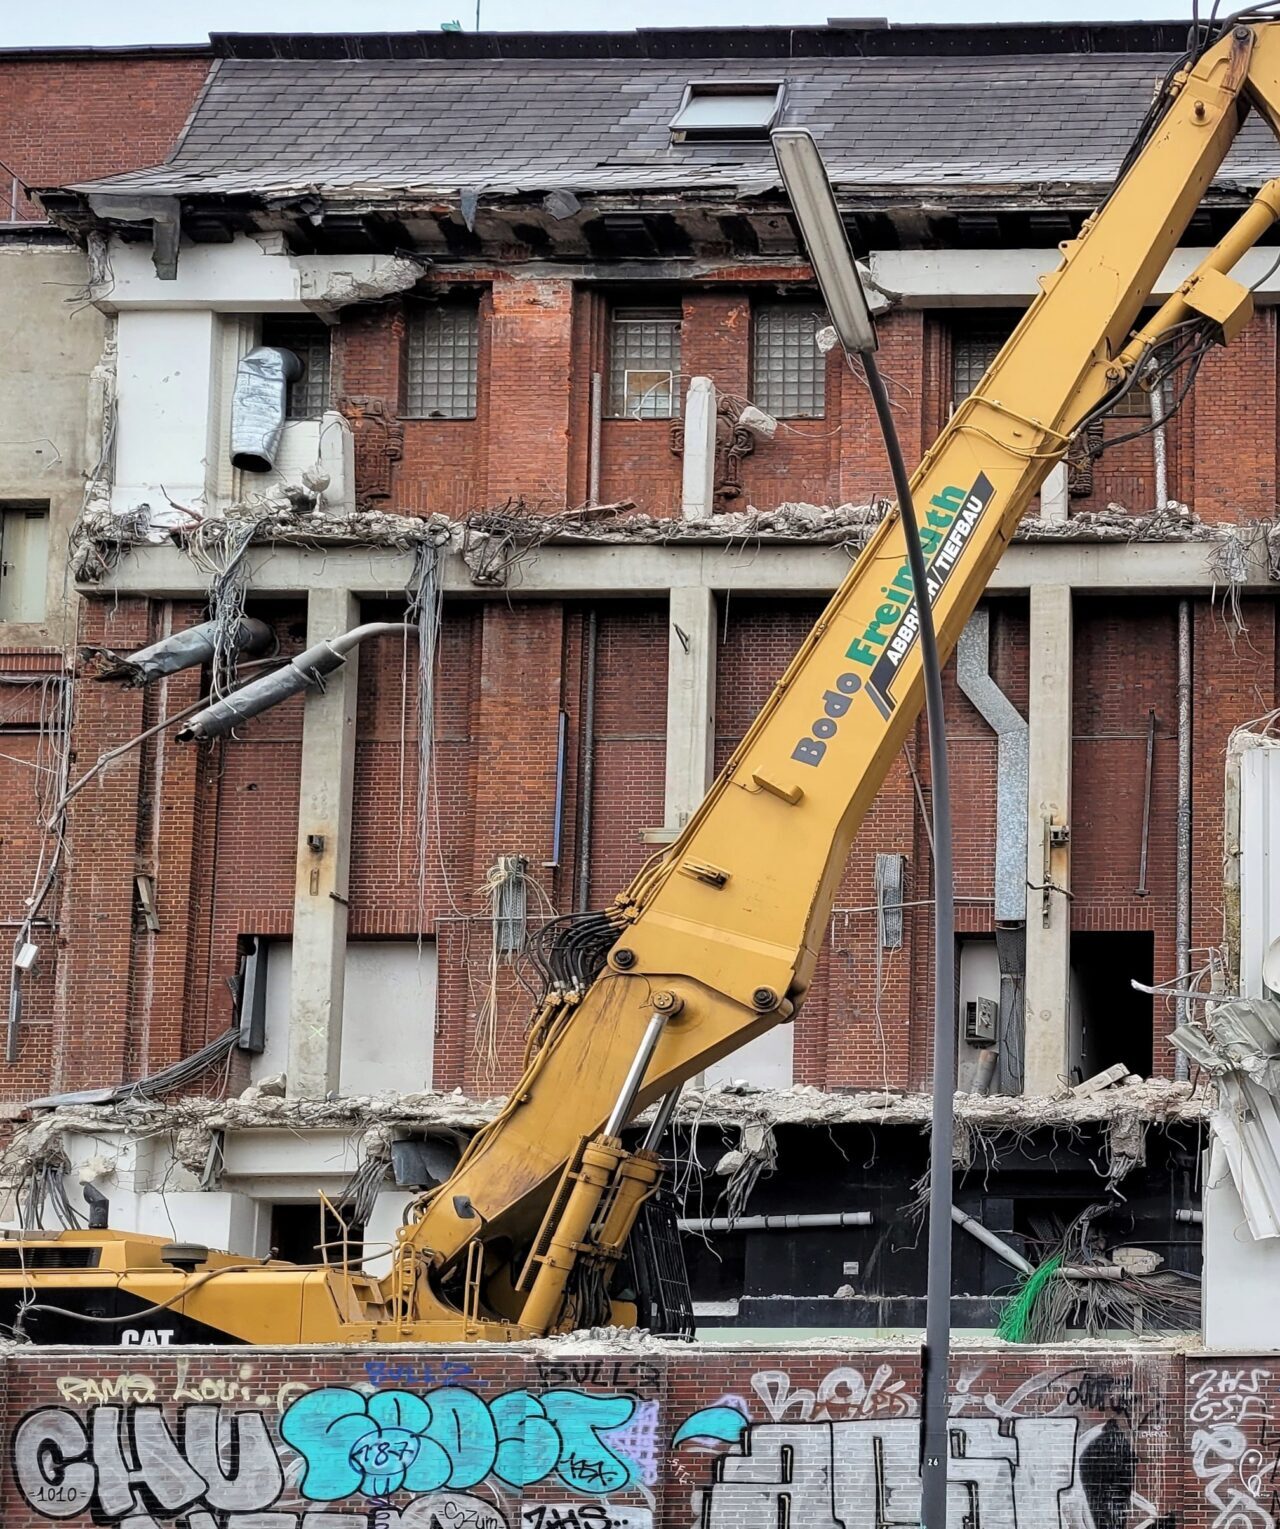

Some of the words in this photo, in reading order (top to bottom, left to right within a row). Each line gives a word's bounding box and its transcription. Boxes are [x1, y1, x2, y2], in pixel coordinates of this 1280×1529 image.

[790, 672, 862, 767] Bodo
[120, 1330, 174, 1345] CAT
[927, 1457, 939, 1467] 26
